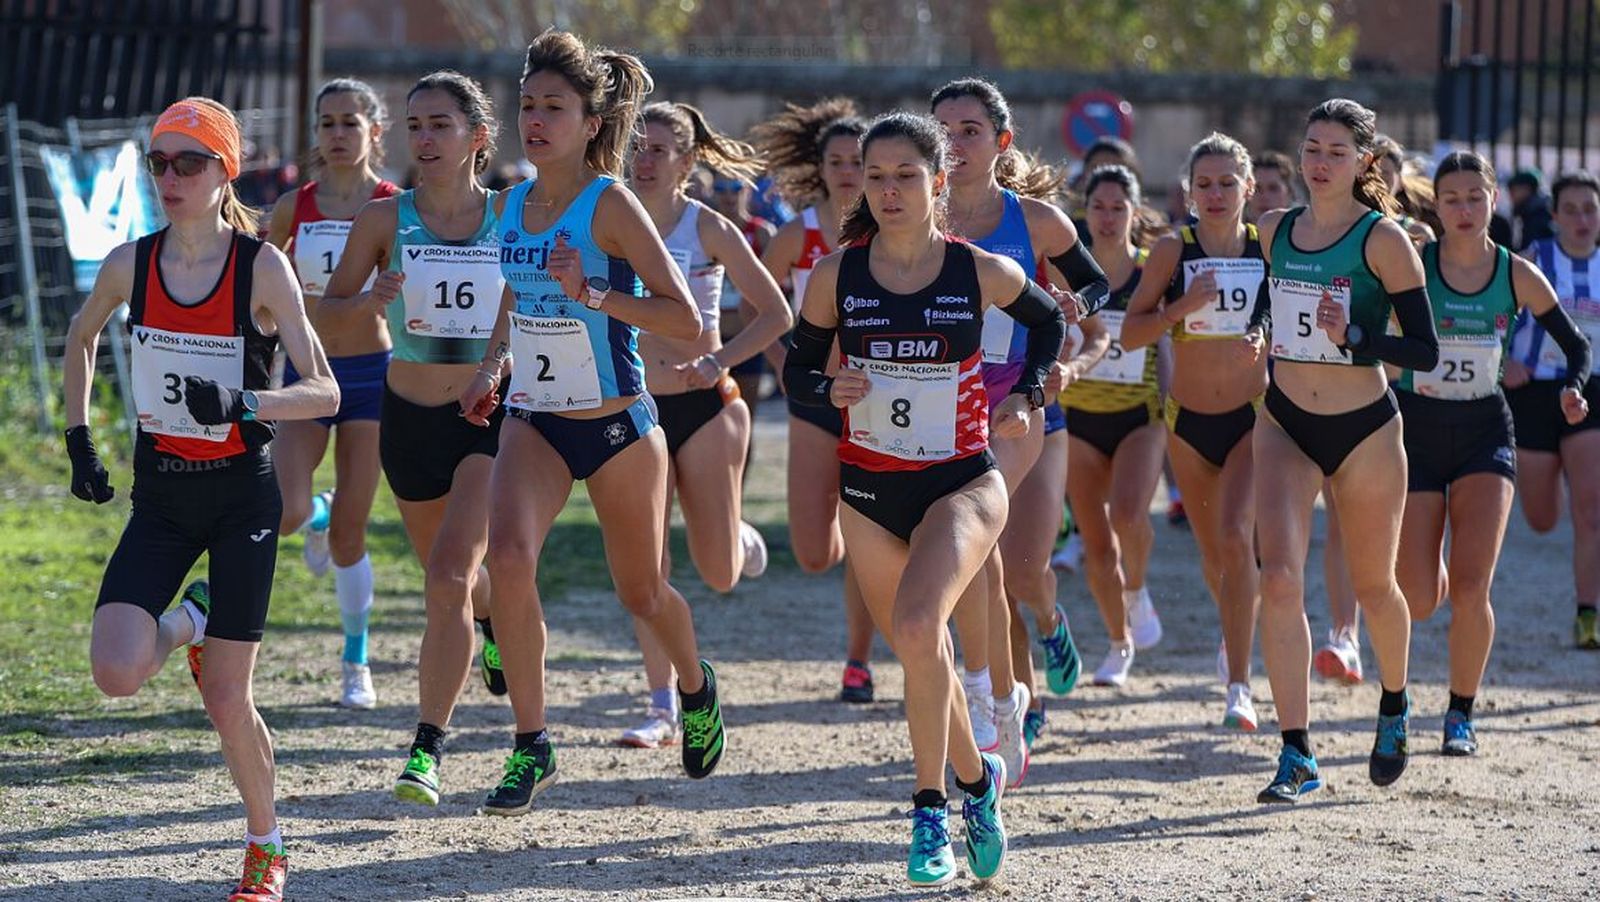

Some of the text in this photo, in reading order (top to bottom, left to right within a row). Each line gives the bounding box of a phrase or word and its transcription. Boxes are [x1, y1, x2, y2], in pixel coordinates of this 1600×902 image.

[423, 248, 451, 257] CROSS
[453, 249, 499, 258] NACIONAL
[501, 240, 549, 270] nerj
[434, 280, 475, 310] 16
[1214, 287, 1248, 312] 19
[535, 320, 579, 329] NACIONAL
[1297, 311, 1312, 338] 5
[152, 333, 180, 346] CROSS
[183, 337, 237, 350] NACIONAL
[897, 340, 939, 358] BM
[1108, 339, 1122, 360] 5
[536, 354, 555, 381] 2
[869, 363, 899, 372] CROSS
[901, 365, 952, 374] NACIONAL
[1441, 360, 1475, 382] 25
[163, 372, 183, 405] 3
[890, 398, 911, 429] 8
